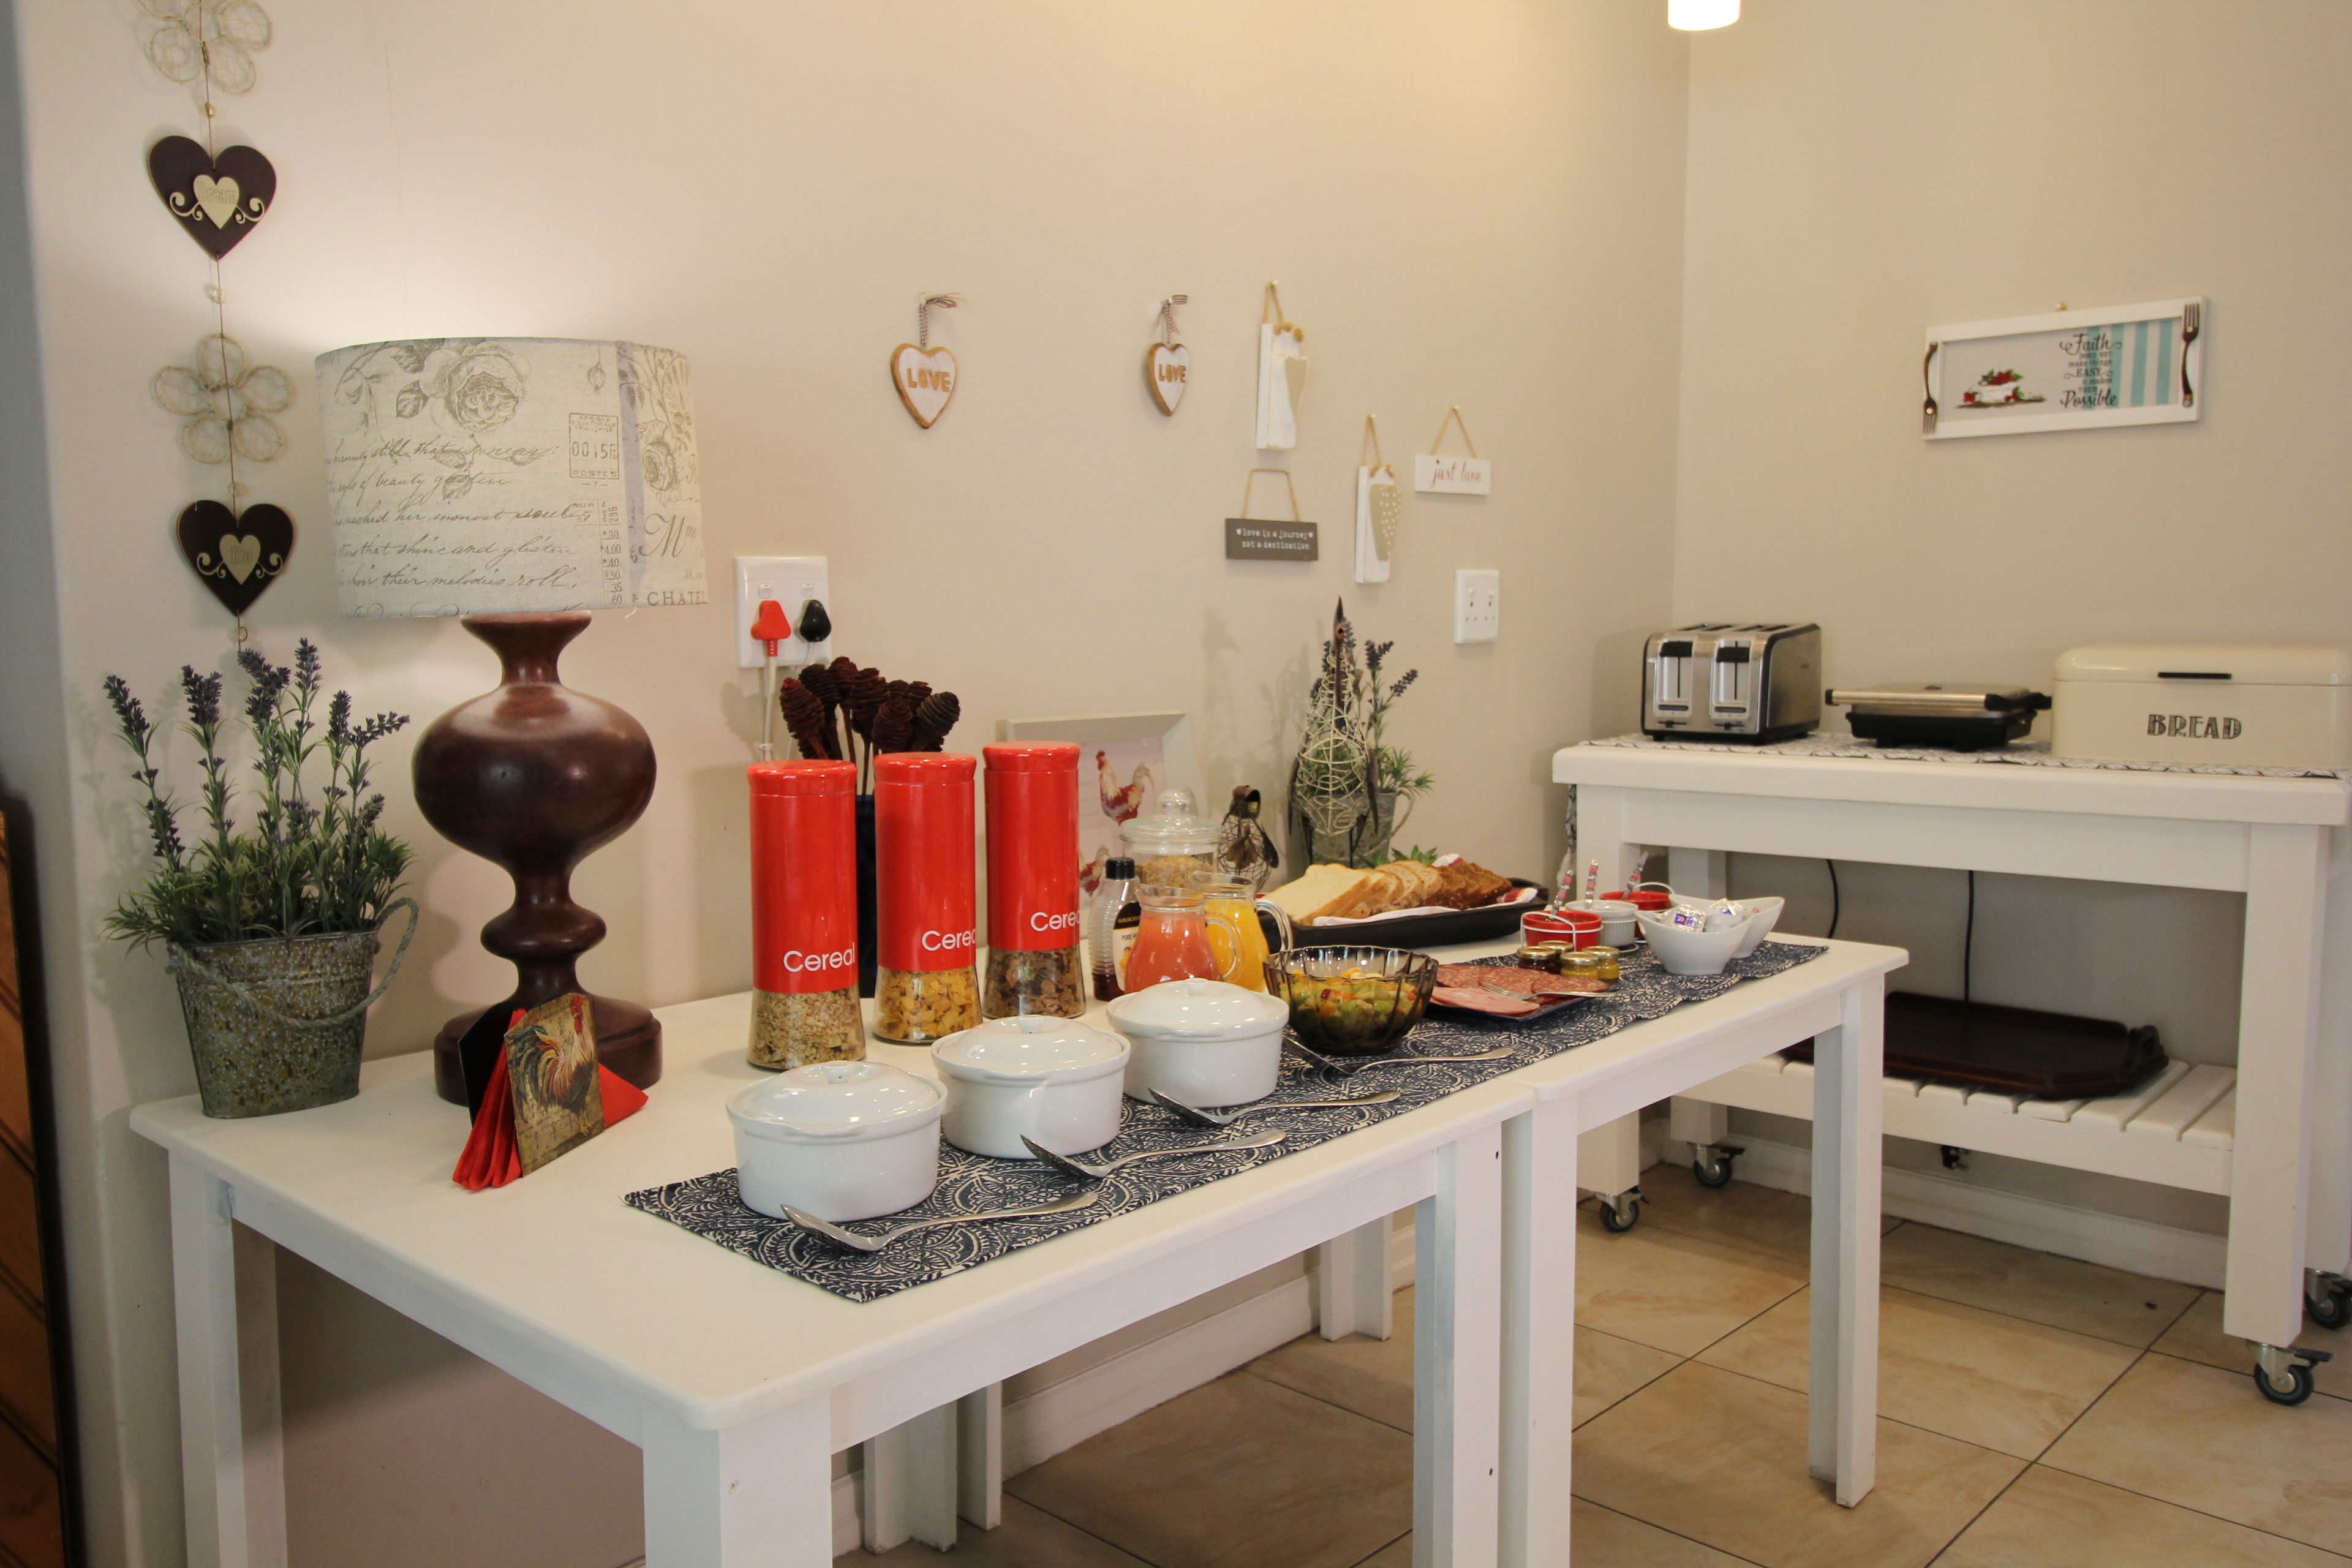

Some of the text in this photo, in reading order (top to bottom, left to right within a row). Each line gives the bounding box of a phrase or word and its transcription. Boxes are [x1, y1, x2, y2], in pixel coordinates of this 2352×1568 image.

[197, 182, 236, 205] Dream
[2059, 333, 2122, 356] Faith
[907, 367, 951, 392] LOVE
[1158, 364, 1186, 383] LOVE
[2076, 367, 2101, 377] EASY
[2060, 388, 2116, 408] Possible
[1430, 461, 1480, 489] just love
[608, 506, 619, 523] 296
[1279, 530, 1308, 540] journey
[230, 547, 253, 564] Do
[1264, 541, 1309, 550] destination
[2147, 714, 2242, 740] BREAD
[783, 942, 855, 973] Cereal
